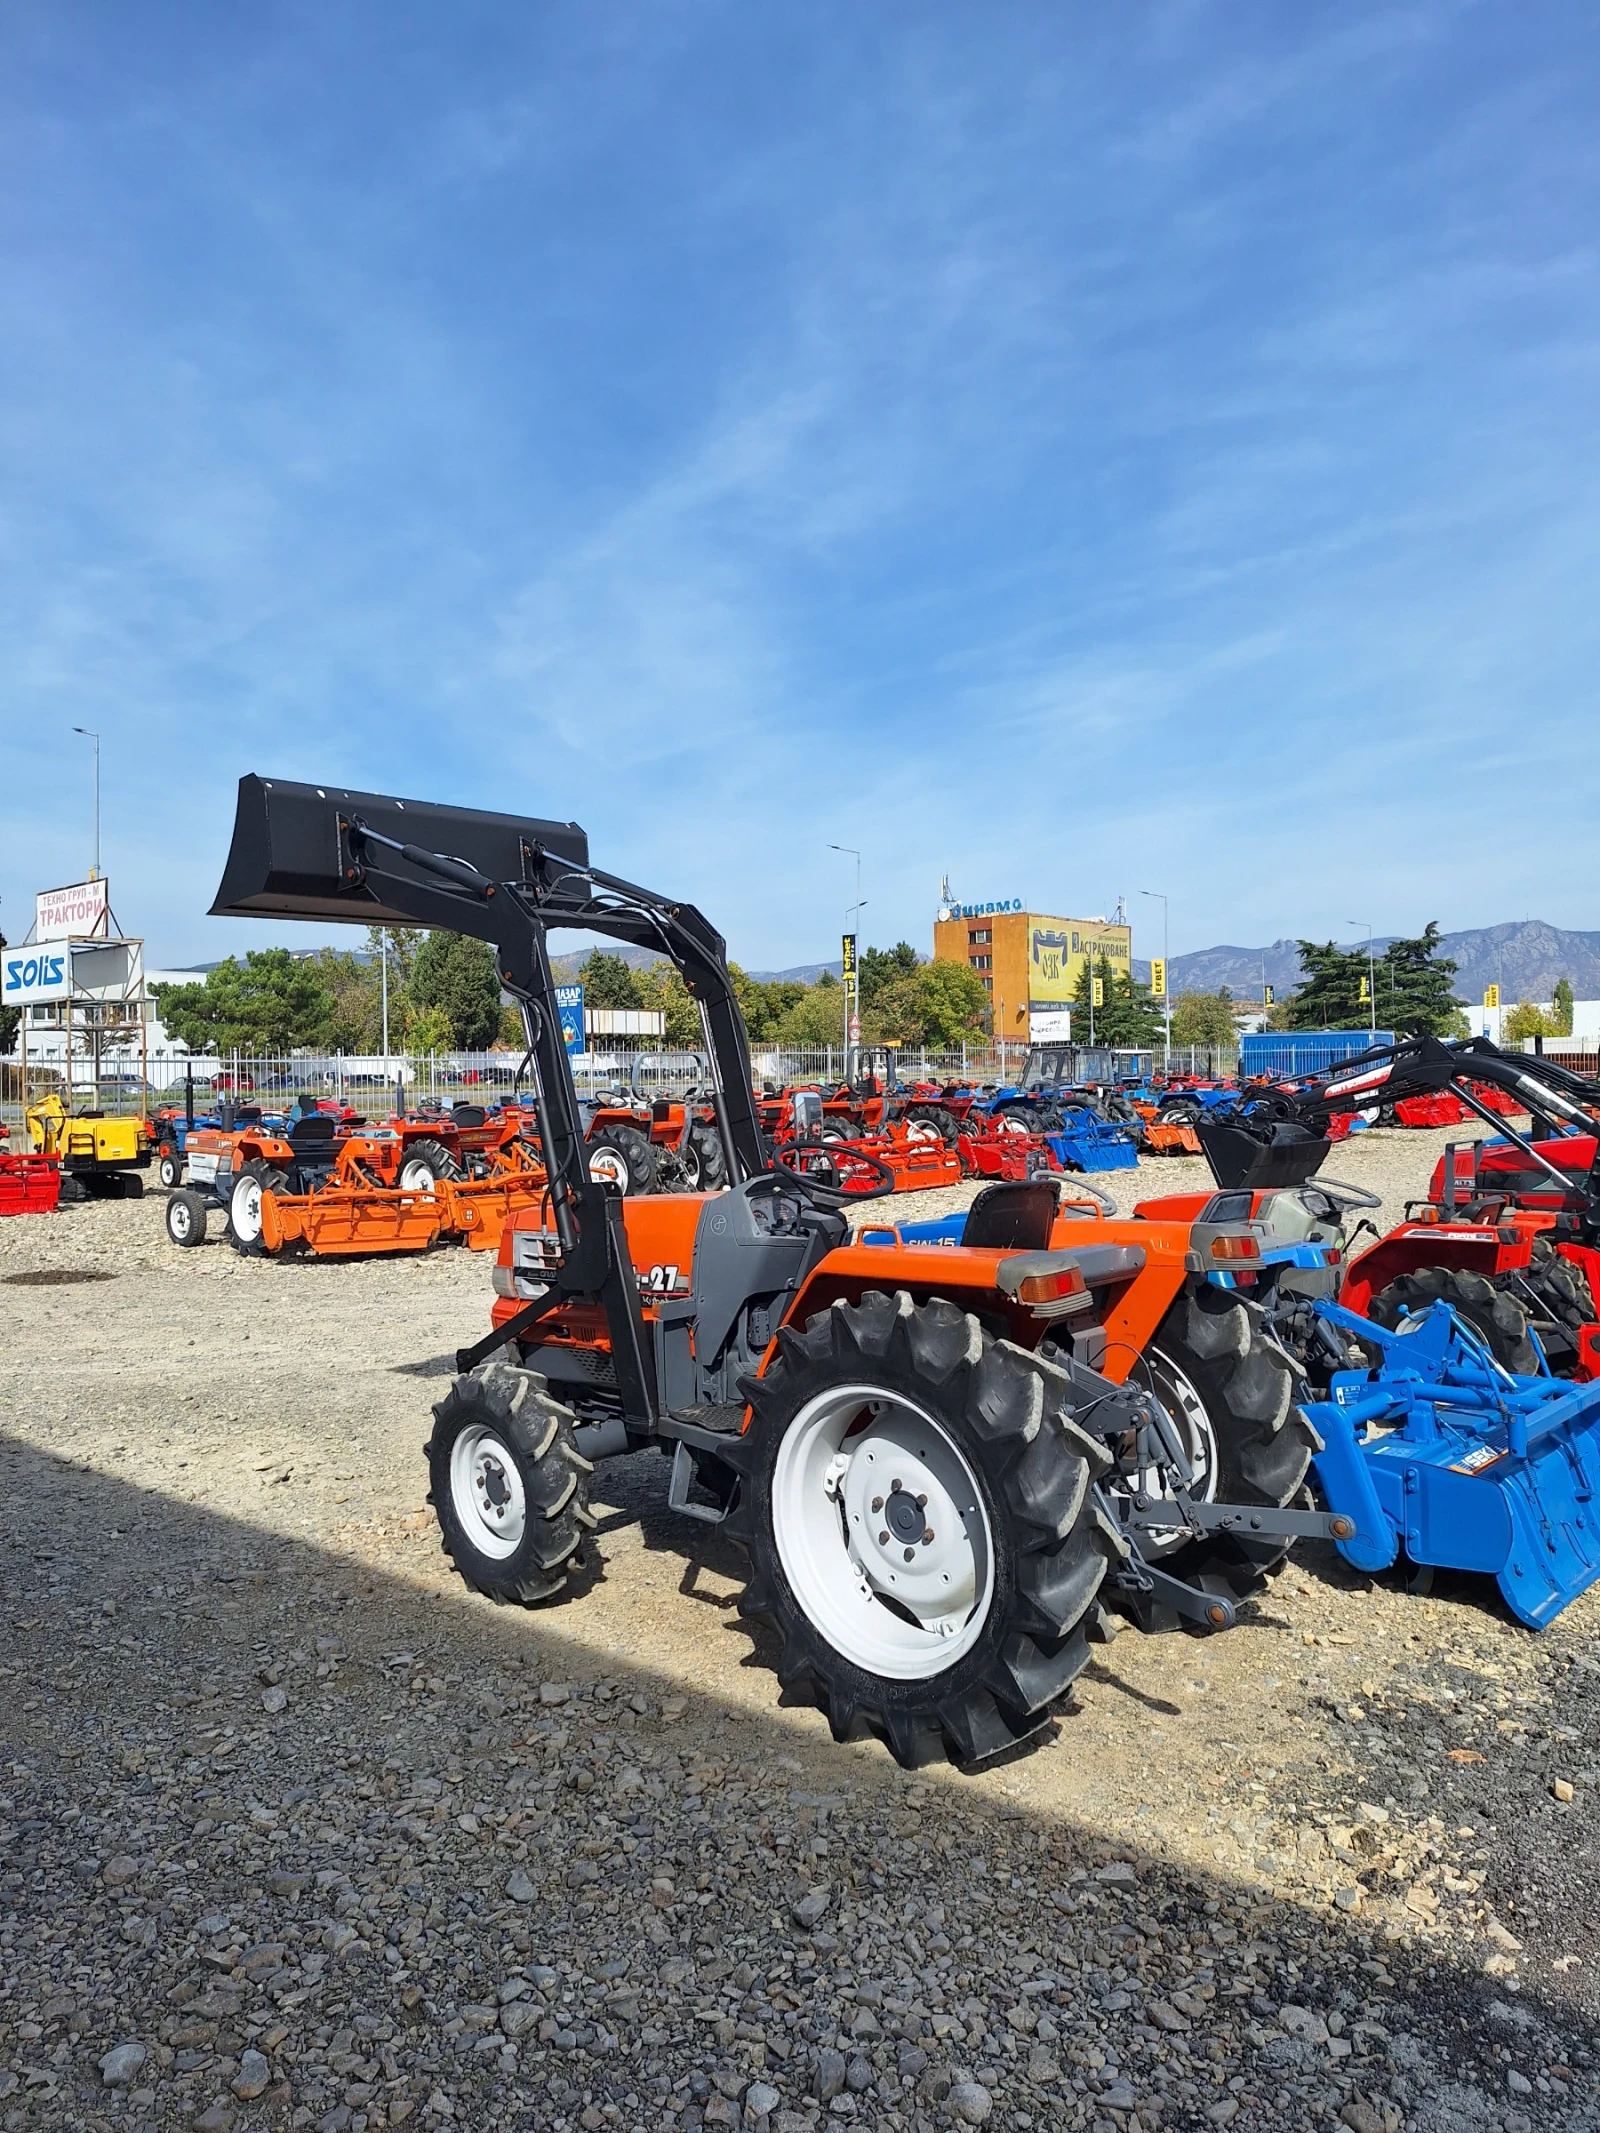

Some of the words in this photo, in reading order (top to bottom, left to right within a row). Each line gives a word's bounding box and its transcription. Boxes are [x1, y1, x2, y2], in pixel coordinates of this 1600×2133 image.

[43, 892, 66, 907] ТЕХНО
[68, 887, 87, 901] ГРУП
[93, 885, 100, 896] М
[40, 898, 102, 927] ТРАКТОРИ
[937, 1237, 956, 1247] 15
